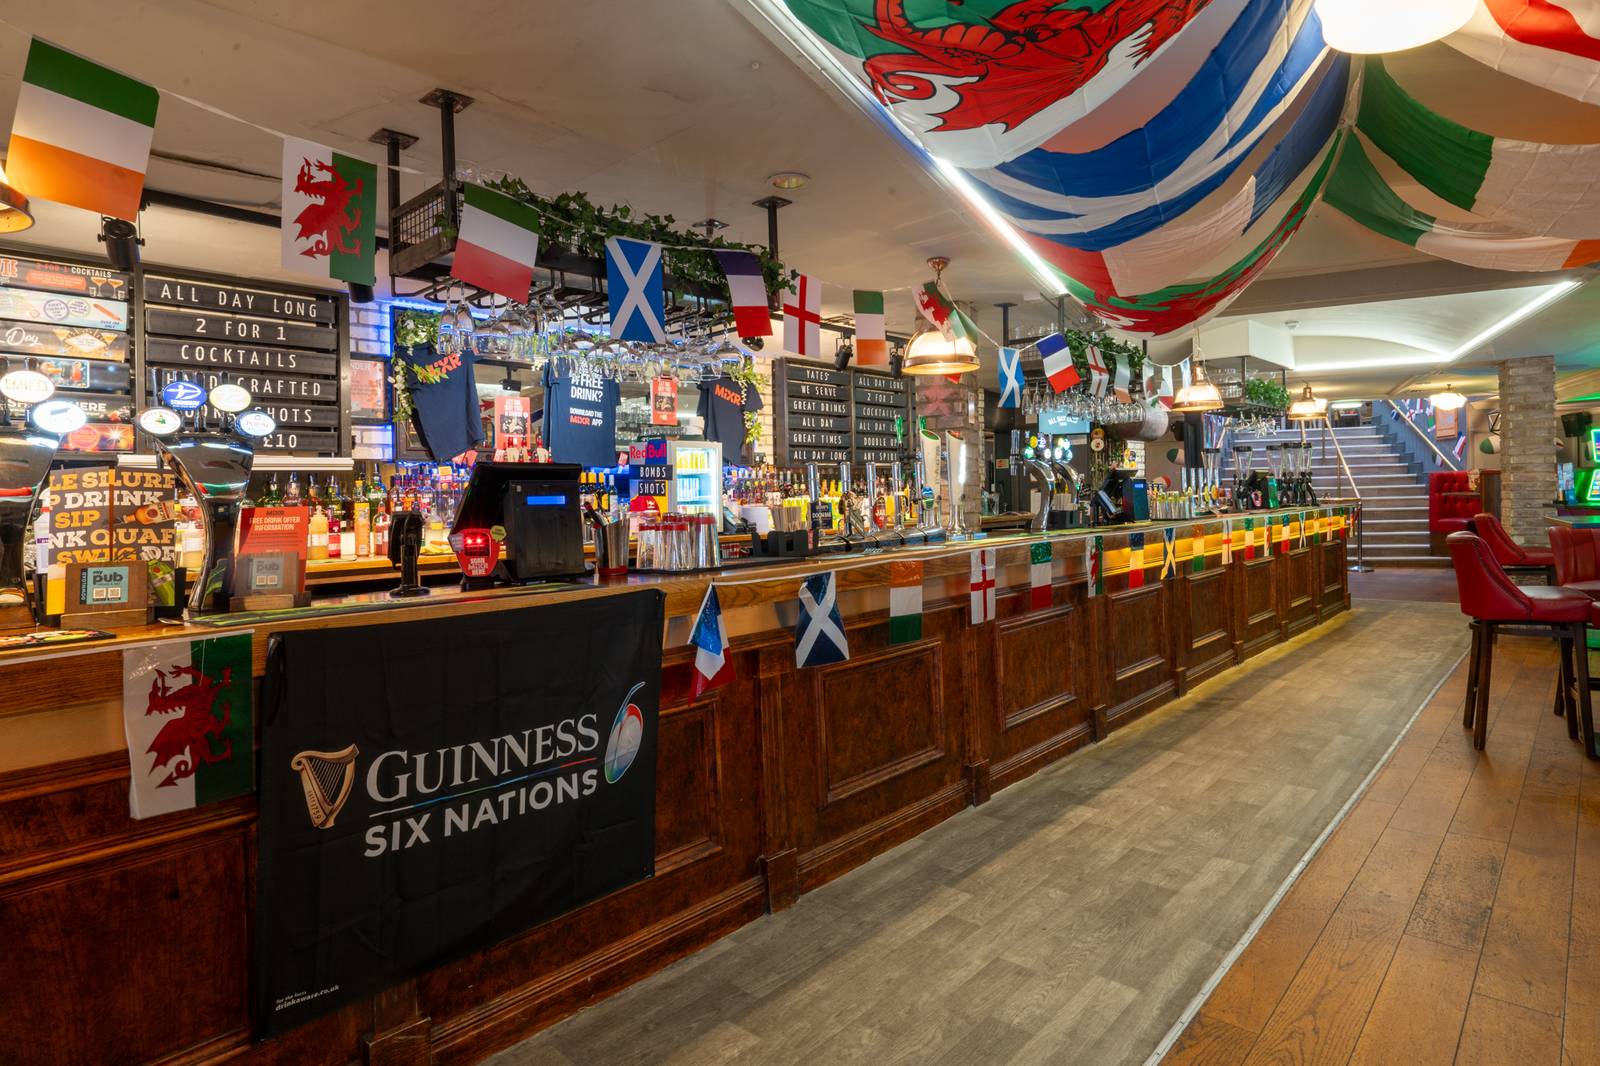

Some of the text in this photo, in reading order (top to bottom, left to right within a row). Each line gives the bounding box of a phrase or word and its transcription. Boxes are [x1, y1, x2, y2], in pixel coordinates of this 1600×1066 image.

[71, 267, 112, 278] COCKTAILS
[161, 284, 317, 317] ALL DAY LONG
[196, 318, 286, 340] 2 FOR 1
[5, 327, 43, 345] Day
[181, 345, 296, 368] COCKTAILS
[237, 377, 321, 396] CRAFTED
[580, 373, 604, 389] FREE
[859, 378, 903, 389] ALL DAY LONG
[571, 386, 603, 402] DRINK?
[801, 385, 837, 397] WE SERVE
[867, 393, 872, 401] 2
[875, 395, 886, 403] FOR
[794, 400, 846, 413] GREAT DRINKS
[595, 410, 603, 418] THE
[802, 418, 833, 428] ALL DAY
[859, 423, 870, 431] ALL
[875, 423, 885, 431] DAY
[264, 434, 297, 448] £10
[794, 434, 842, 445] GREAT TIMES
[864, 437, 886, 446] DOUBLE
[794, 451, 847, 461] ALL DAY LONG
[864, 453, 875, 461] ANY
[640, 466, 666, 478] BOMBS
[640, 483, 665, 494] SHOTS
[65, 491, 164, 509] DRINK
[55, 510, 100, 528] SIP
[283, 516, 301, 524] OFFER
[93, 572, 123, 585] pub
[366, 713, 600, 803] GUINNESS
[364, 769, 599, 858] SIX NATIONS
[275, 984, 339, 1011] drinkaware.co.uk
